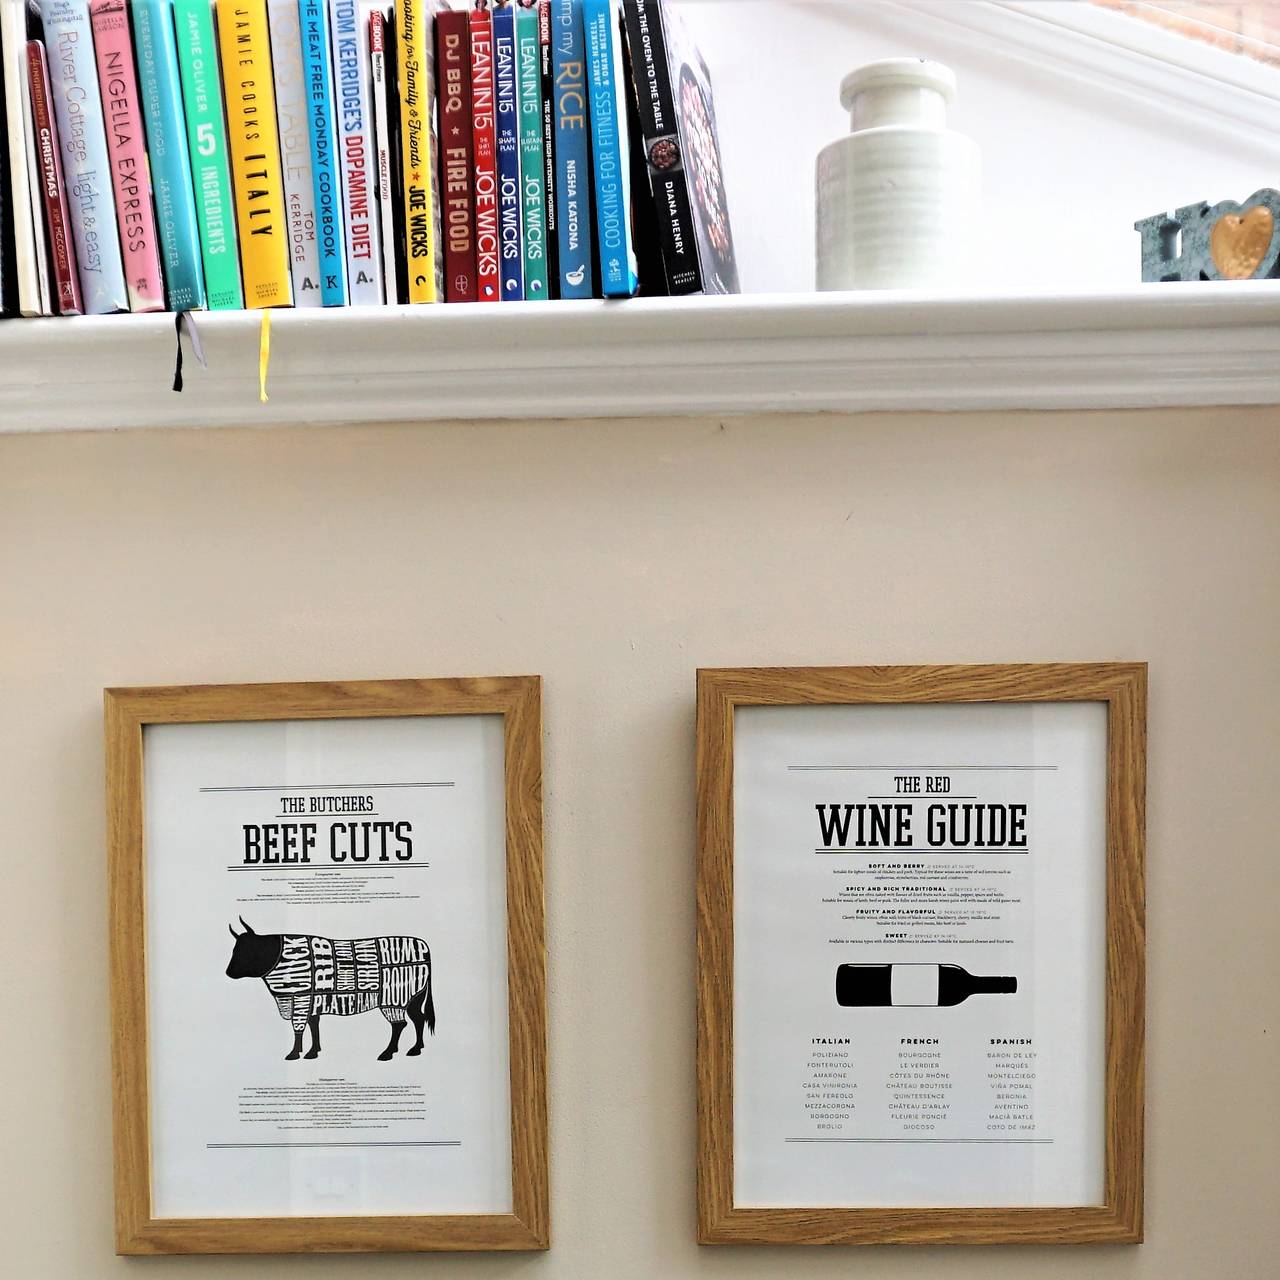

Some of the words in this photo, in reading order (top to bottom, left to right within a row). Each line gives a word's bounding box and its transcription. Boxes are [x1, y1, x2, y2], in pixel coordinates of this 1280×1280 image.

[187, 11, 203, 54] JAMIE
[234, 9, 253, 66] JAMIE
[336, 0, 356, 34] TOM
[402, 0, 416, 43] ooking
[639, 14, 649, 34] THE
[57, 31, 78, 82] River
[308, 21, 322, 61] MEAT
[445, 34, 461, 62] DJ
[472, 31, 491, 83] LEAN
[496, 37, 513, 78] LEAN
[521, 37, 536, 78] LEAN
[558, 32, 573, 55] my
[590, 21, 600, 57] HASKELL
[642, 35, 654, 62] OVEN
[192, 58, 207, 114] OLIVER
[311, 64, 324, 100] FREE
[339, 38, 362, 133] KERRIDGE'S
[404, 60, 420, 108] Family
[446, 68, 463, 114] BBQ
[498, 80, 513, 97] IN
[522, 80, 536, 97] IN
[593, 59, 601, 87] JAMES
[646, 63, 656, 78] TO
[649, 79, 660, 99] THE
[105, 51, 131, 149] NIGELLA
[241, 80, 260, 141] COOKS
[409, 109, 418, 119] &
[473, 87, 492, 108] IN
[499, 100, 514, 113] 15
[523, 100, 538, 113] 15
[555, 61, 584, 130] RICE
[652, 99, 664, 130] TABLE
[64, 86, 87, 162] Cottage
[197, 123, 216, 156] 5
[314, 104, 330, 166] MONDAY
[474, 112, 493, 129] 15
[595, 92, 614, 147] FITNESS
[40, 127, 58, 198] CHRISTMAS
[408, 119, 423, 169] Friends
[500, 144, 515, 152] PLAN
[600, 149, 617, 180] FOR
[345, 135, 371, 218] DOPAMINE
[446, 148, 466, 193] FIRE
[476, 165, 495, 206] JOE
[501, 173, 516, 205] JOE
[525, 174, 540, 206] JOE
[566, 160, 577, 197] NISHA
[72, 170, 99, 214] light
[117, 157, 146, 253] EXPRESS
[201, 166, 226, 255] INGREDIENTS
[244, 153, 273, 236] ITALY
[409, 185, 426, 212] JOE
[82, 217, 96, 230] &
[290, 193, 306, 263] KERRIDGE
[303, 211, 315, 241] TOM
[319, 172, 336, 258] COOKBOOK
[409, 213, 428, 259] WICKS
[448, 199, 469, 253] FOOD
[502, 207, 518, 259] WICKS
[526, 208, 542, 260] WICKS
[568, 200, 579, 251] KATONA
[602, 183, 621, 248] COOKING
[664, 181, 677, 217] DIANA
[671, 219, 685, 255] HENRY
[83, 230, 103, 274] easy
[350, 219, 371, 260] DIET
[478, 209, 497, 276] WICKS
[280, 796, 306, 814] THE
[309, 795, 375, 813] BUTCHERS
[894, 776, 921, 794] THE
[925, 776, 951, 794] RED
[242, 823, 317, 865] BEEF
[330, 821, 414, 863] CUTS
[815, 803, 913, 847] WINE
[927, 803, 1027, 847] GUIDE
[267, 935, 312, 994] CHUCK
[311, 936, 335, 992] RIB
[334, 939, 354, 958] LOIN
[354, 937, 380, 991] SIRLOIN
[378, 937, 429, 965] RUMP
[336, 963, 356, 992] SHORT
[381, 964, 429, 1008] ROUND
[293, 993, 312, 1032] SHANK
[312, 993, 355, 1016] PLATE
[356, 992, 380, 1014] FLANK
